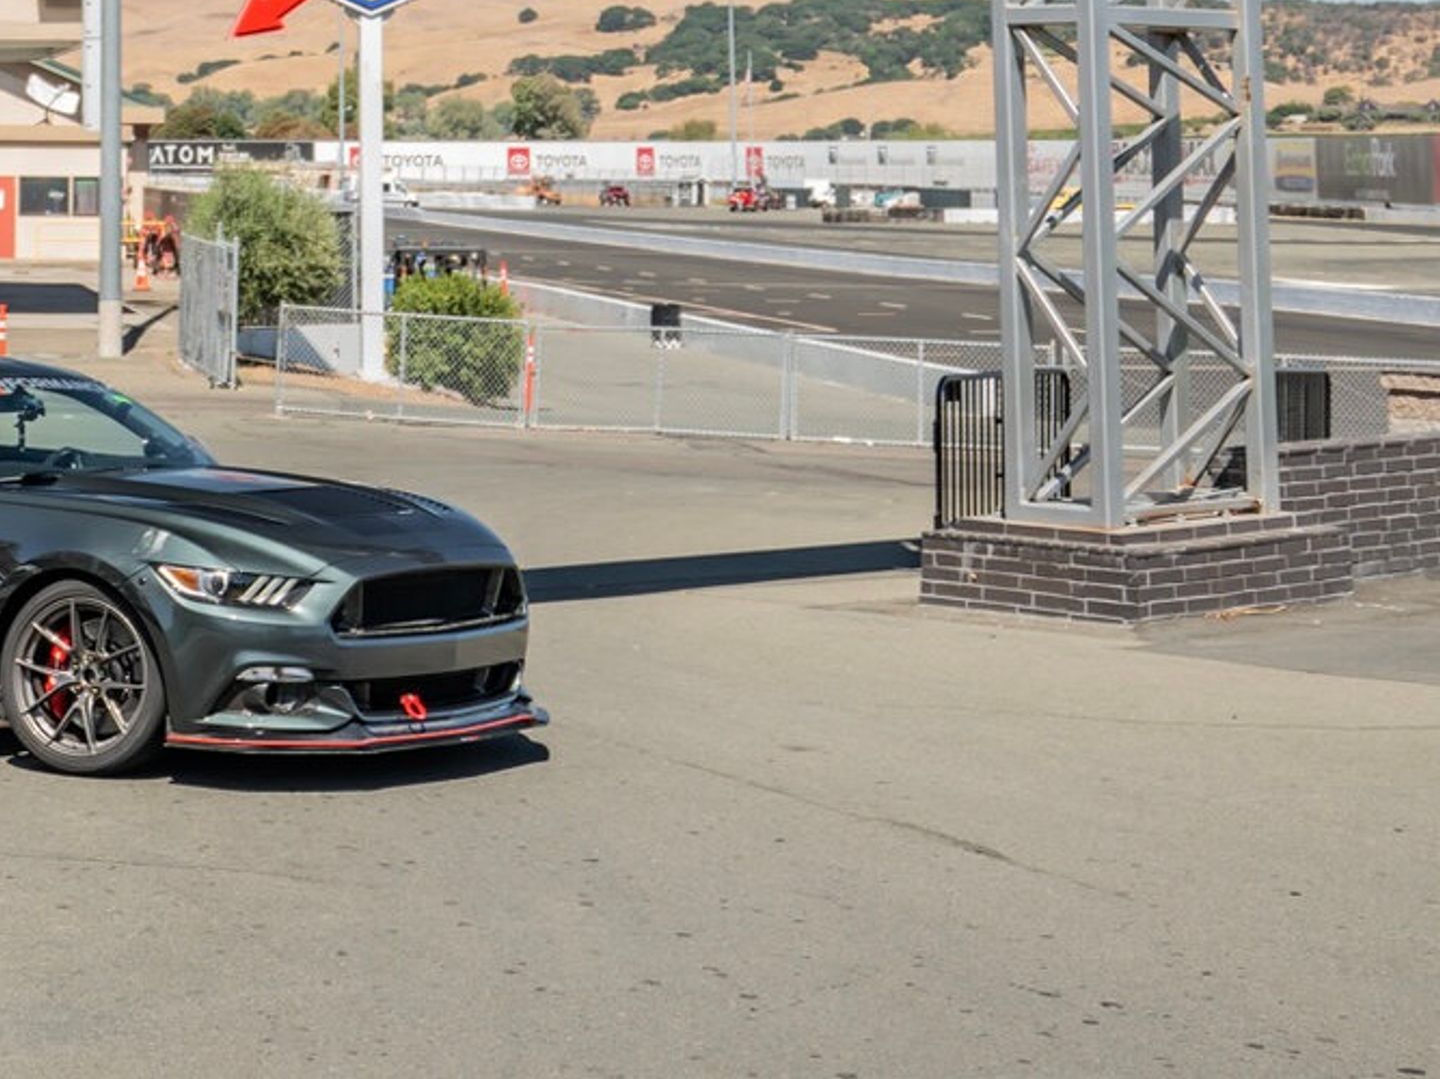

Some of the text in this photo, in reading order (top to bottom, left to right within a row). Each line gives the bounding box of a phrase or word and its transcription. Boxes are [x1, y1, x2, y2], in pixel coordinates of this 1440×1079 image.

[149, 144, 214, 164] ATOM
[383, 154, 444, 167] TOYOTA
[536, 155, 587, 167] TOYOTA
[659, 155, 701, 168] TOYOTA
[767, 155, 805, 168] TOYOTA
